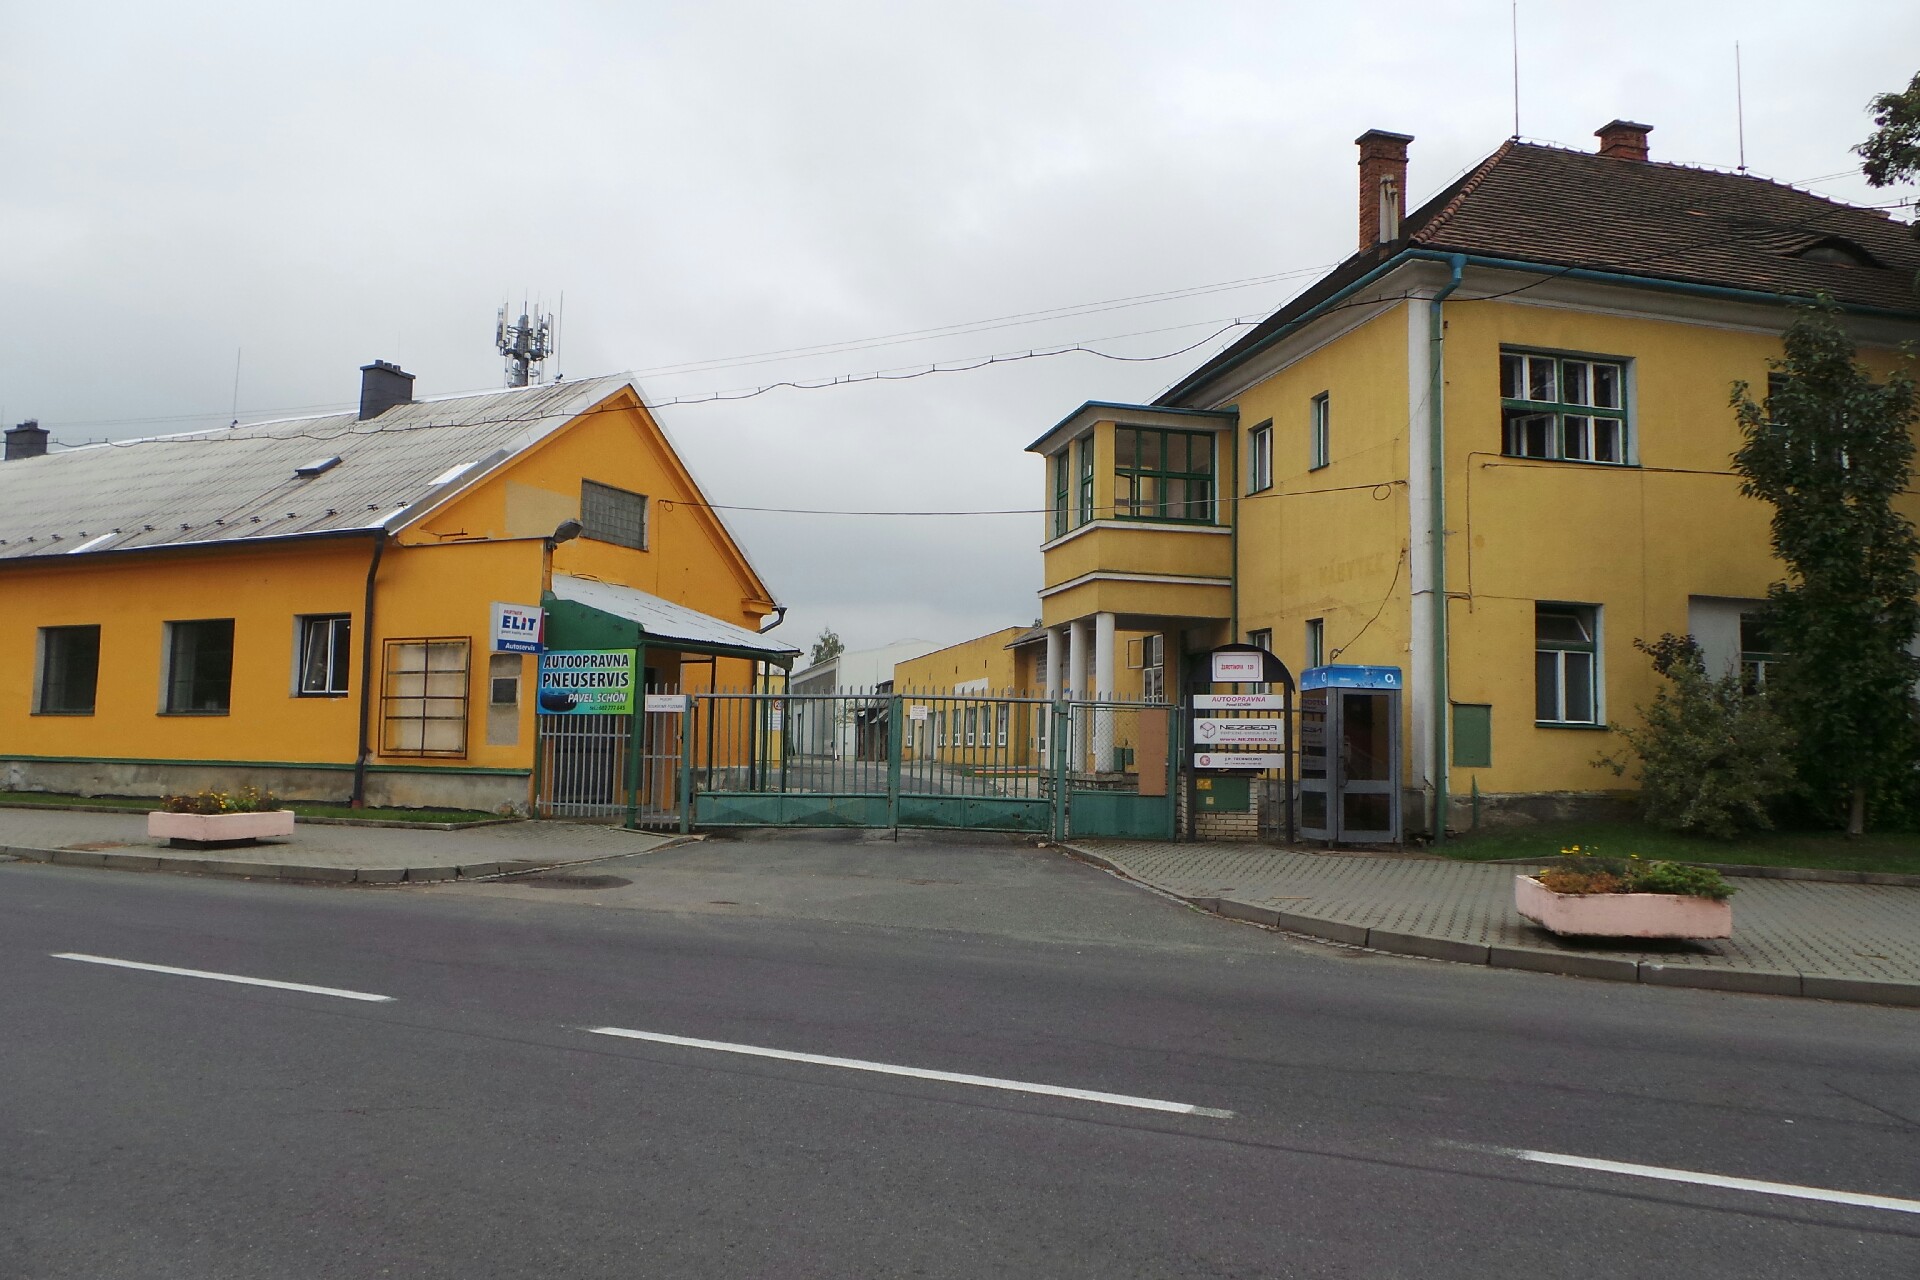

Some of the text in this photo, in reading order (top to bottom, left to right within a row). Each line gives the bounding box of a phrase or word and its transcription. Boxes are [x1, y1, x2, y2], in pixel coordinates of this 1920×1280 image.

[504, 642, 536, 652] Autoservis
[543, 654, 629, 669] AUTOOPRAVNA
[542, 672, 629, 688] PNEUSERVIS
[567, 691, 626, 703] PAVEL SCHÖN
